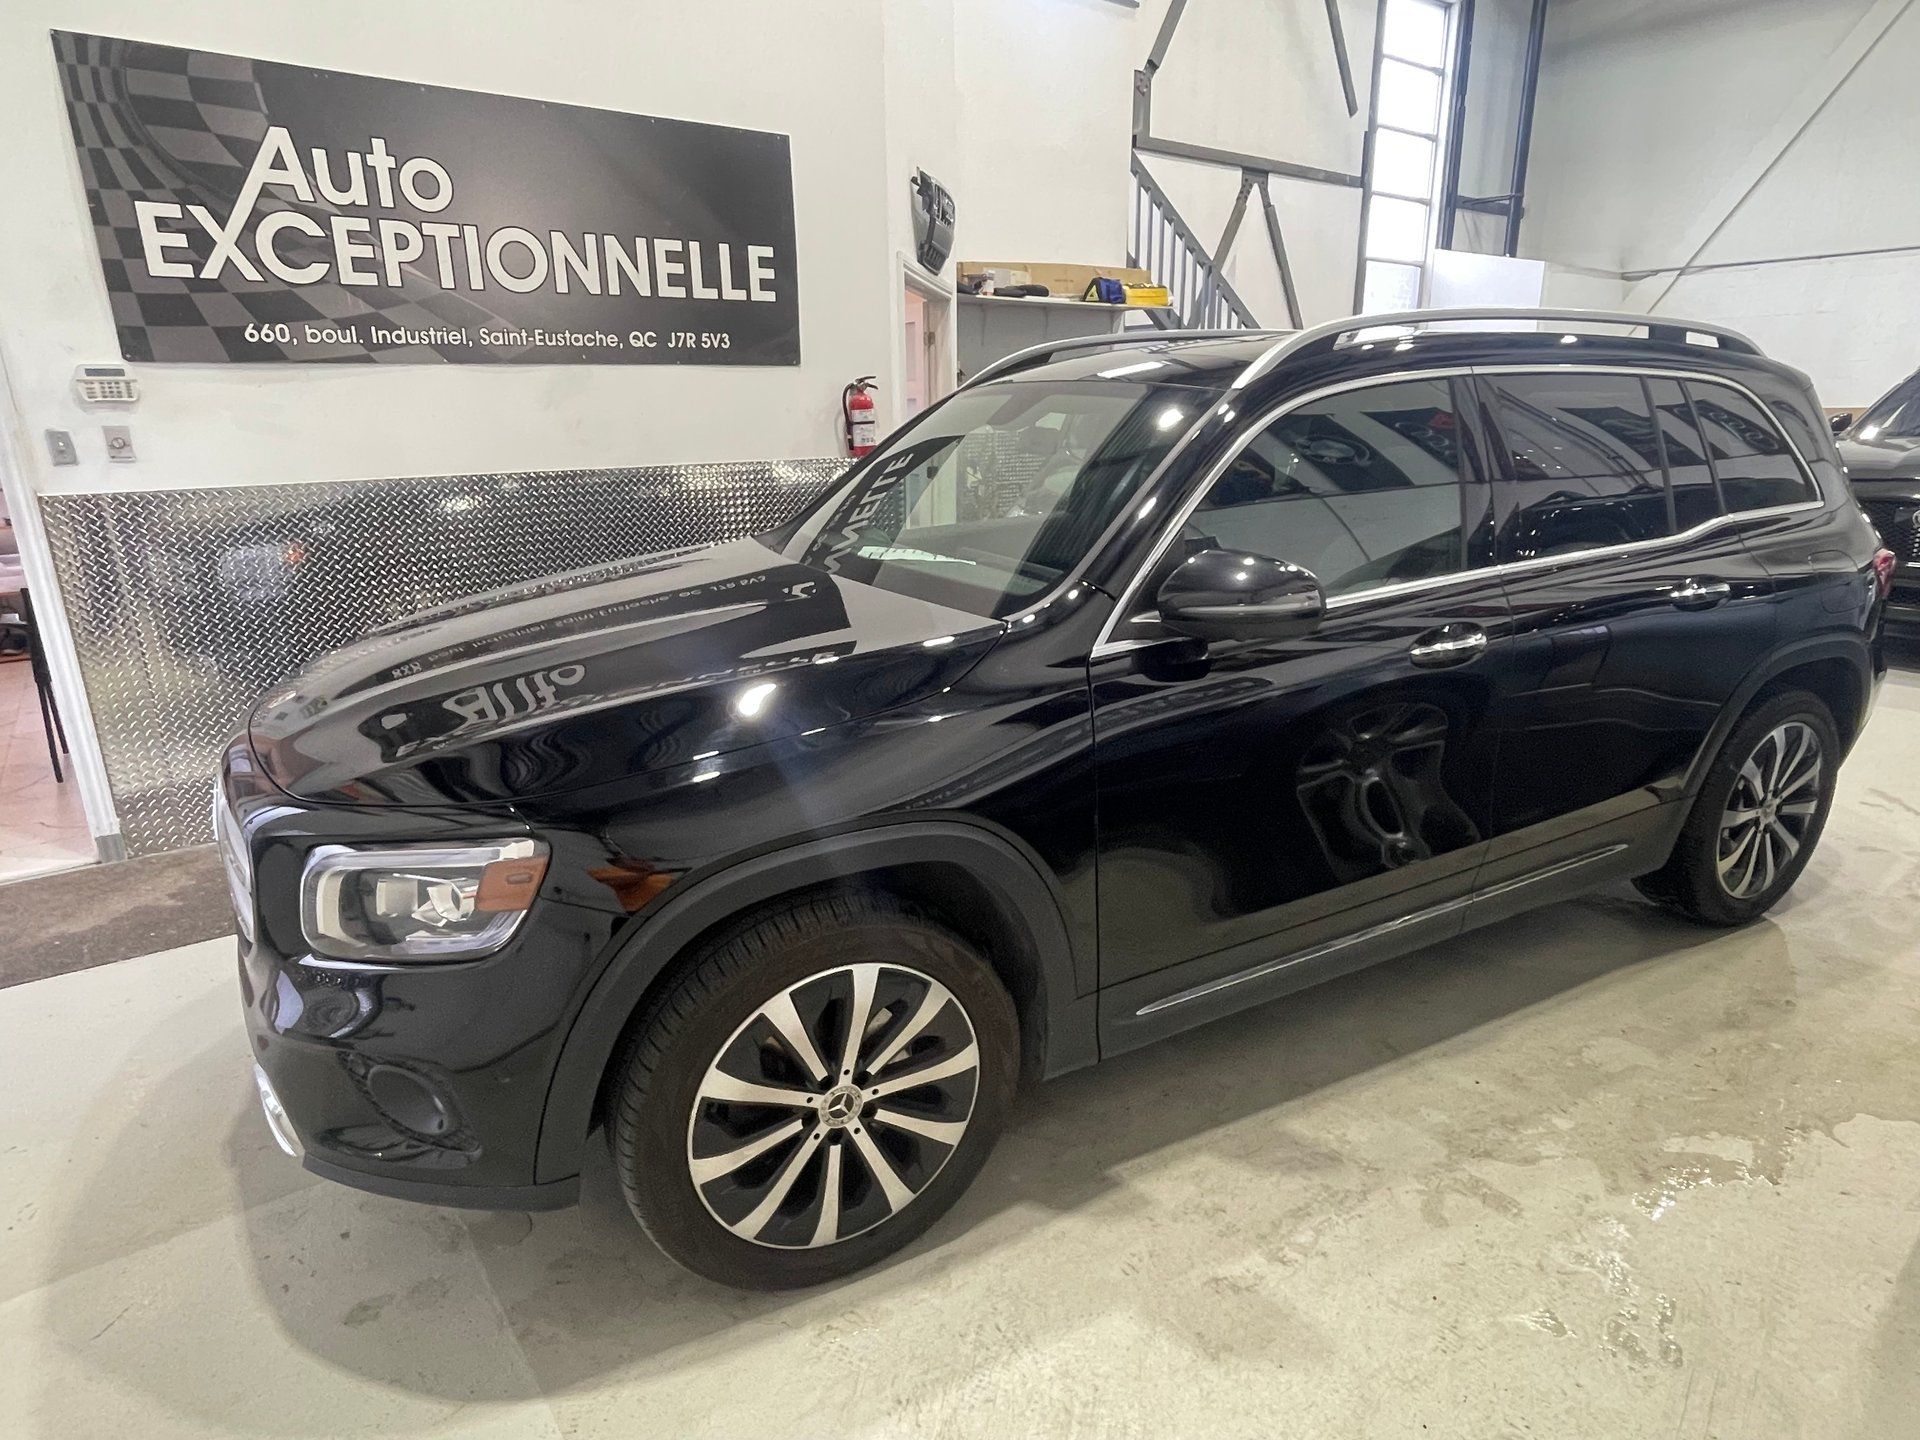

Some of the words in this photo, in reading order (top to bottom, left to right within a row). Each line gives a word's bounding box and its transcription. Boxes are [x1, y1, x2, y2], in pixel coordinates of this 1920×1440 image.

[236, 125, 453, 213] Auto
[134, 200, 777, 302] EXCEPTIONNELLE
[243, 323, 298, 346] 660,
[304, 324, 365, 344] boul.
[370, 325, 474, 347] Industriel,
[479, 327, 624, 349] Saint-Eustache,
[628, 331, 658, 348] QC
[667, 332, 697, 348] J7R
[700, 332, 731, 349] 5V3
